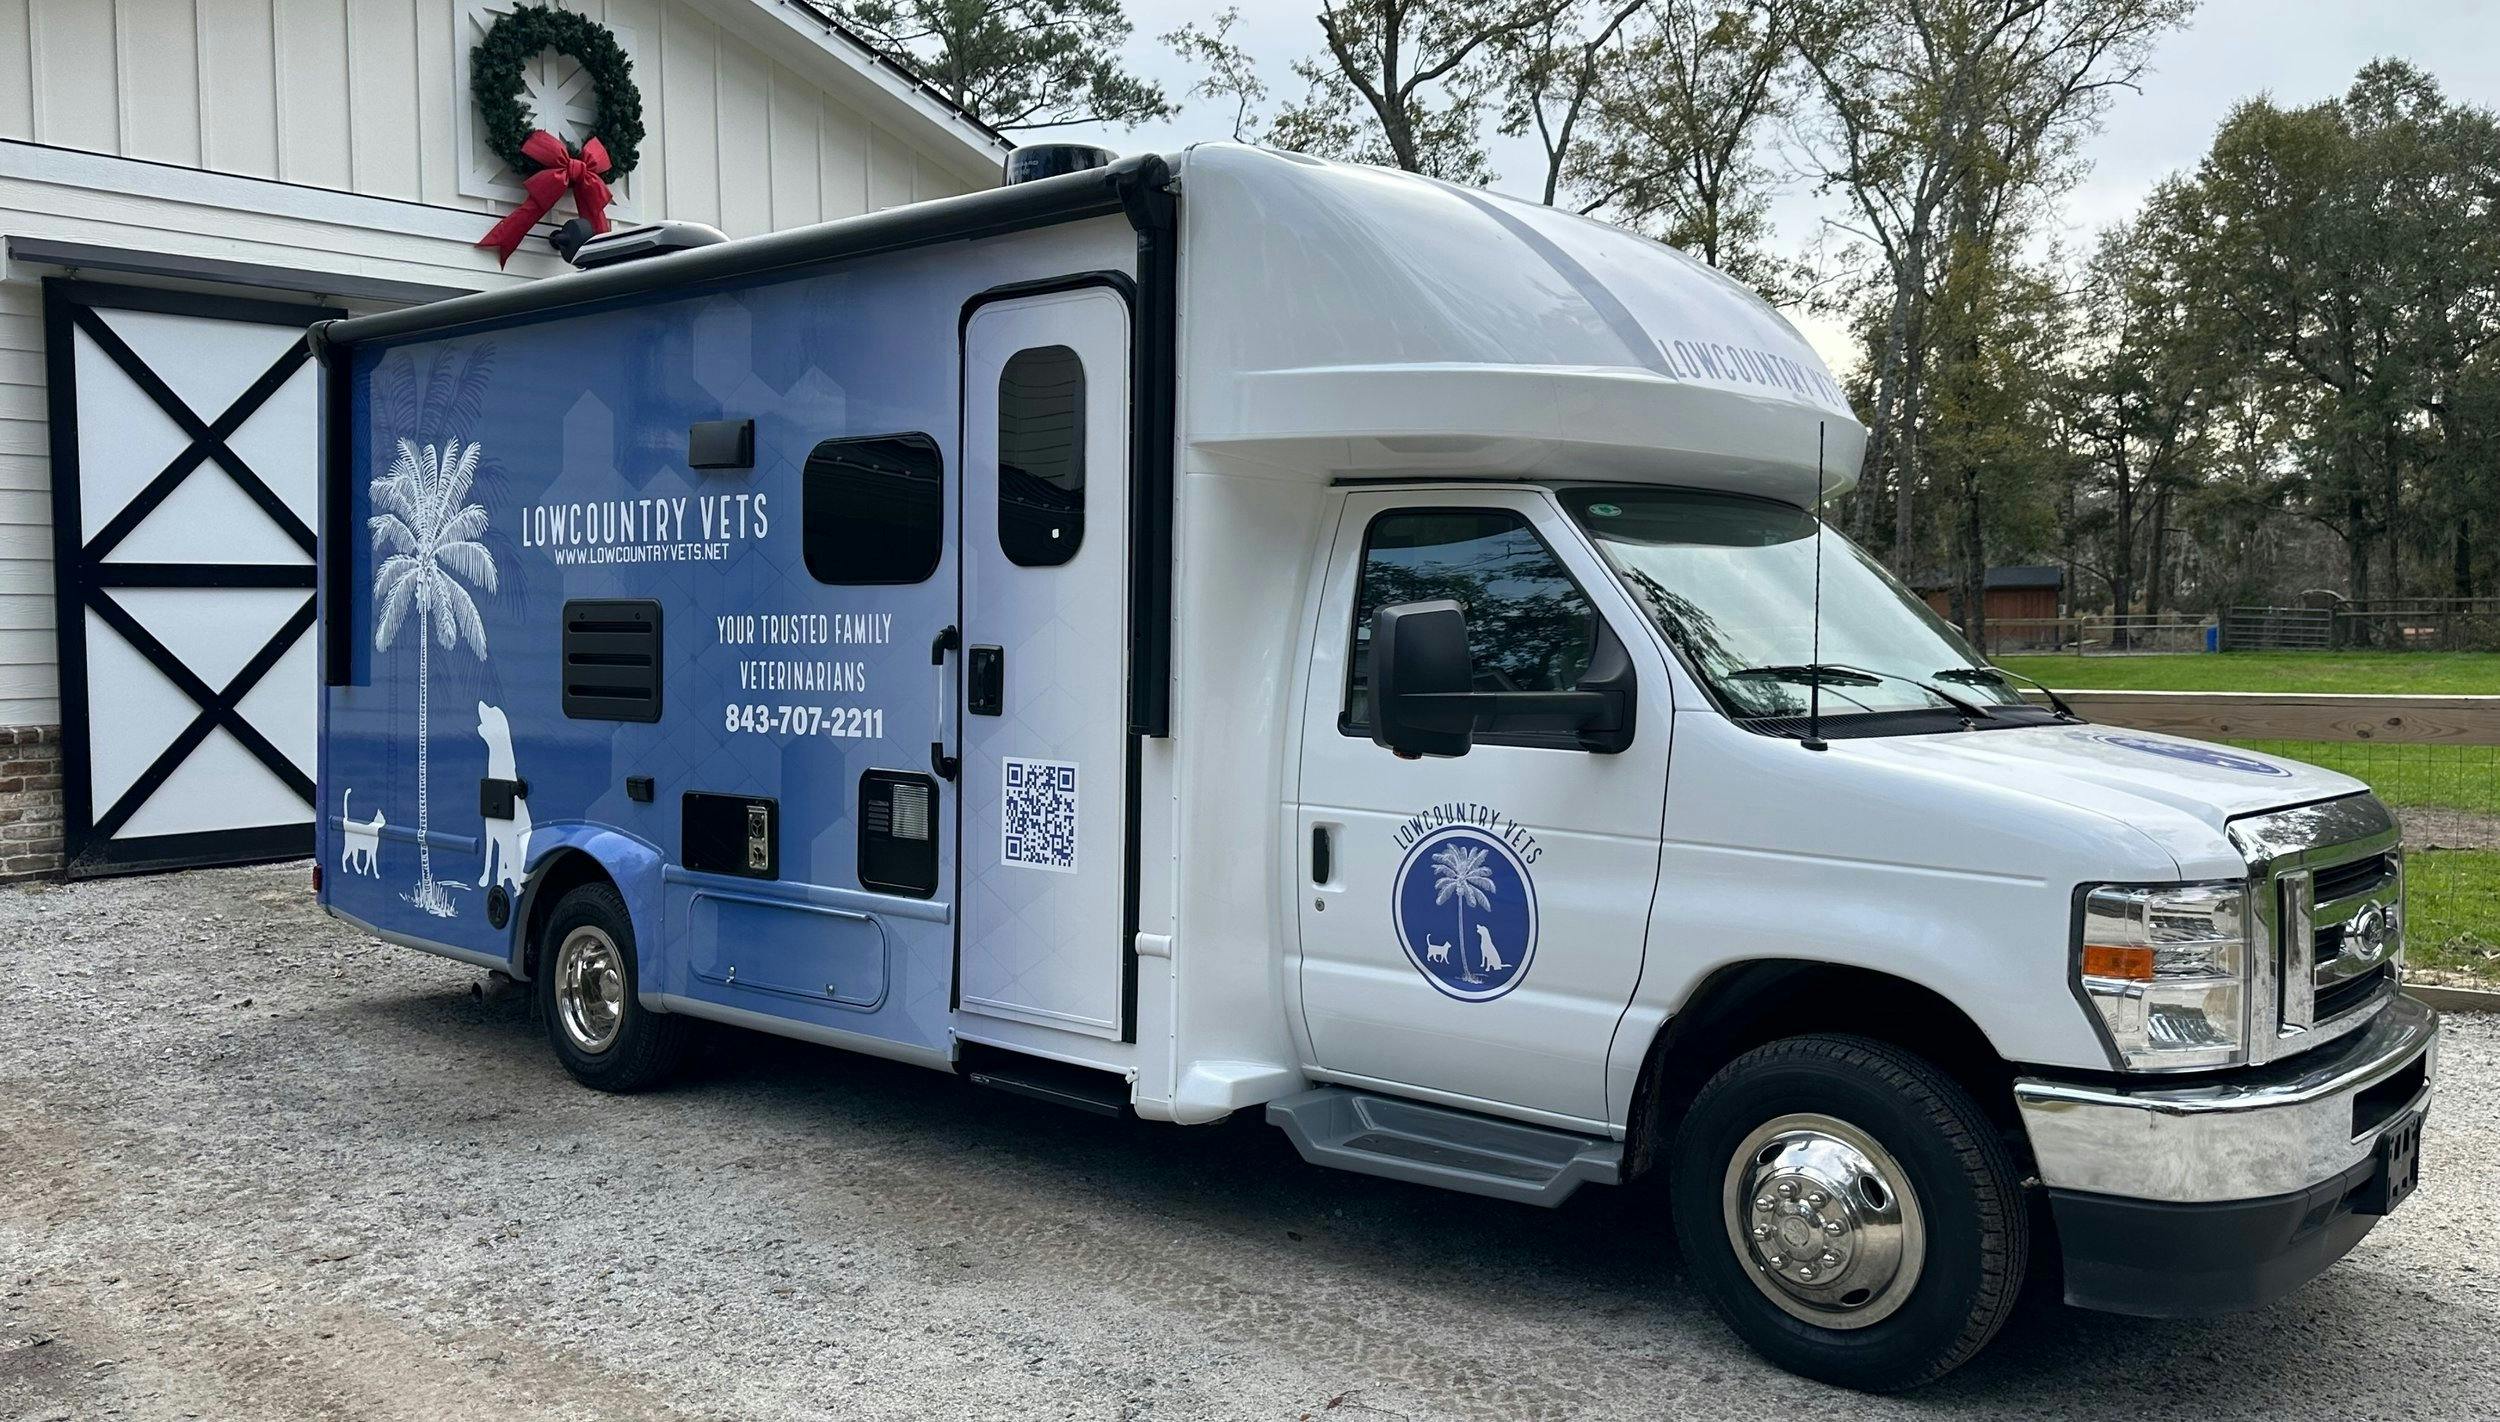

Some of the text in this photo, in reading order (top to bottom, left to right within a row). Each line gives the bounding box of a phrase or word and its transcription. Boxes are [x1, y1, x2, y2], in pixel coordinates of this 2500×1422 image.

[1658, 339, 1813, 397] LOWCOUNTRY
[523, 493, 768, 547] LOWCOUNTRY VETS
[554, 543, 729, 565] WWW.LOWCOUNTRYVETS.NET
[717, 613, 892, 645] YOUR TRUSTED FAMILY
[740, 660, 866, 692] VETERINARIANS
[725, 703, 883, 739] 843-707-2211
[1393, 802, 1543, 865] LOWCOUNTRY VETS
